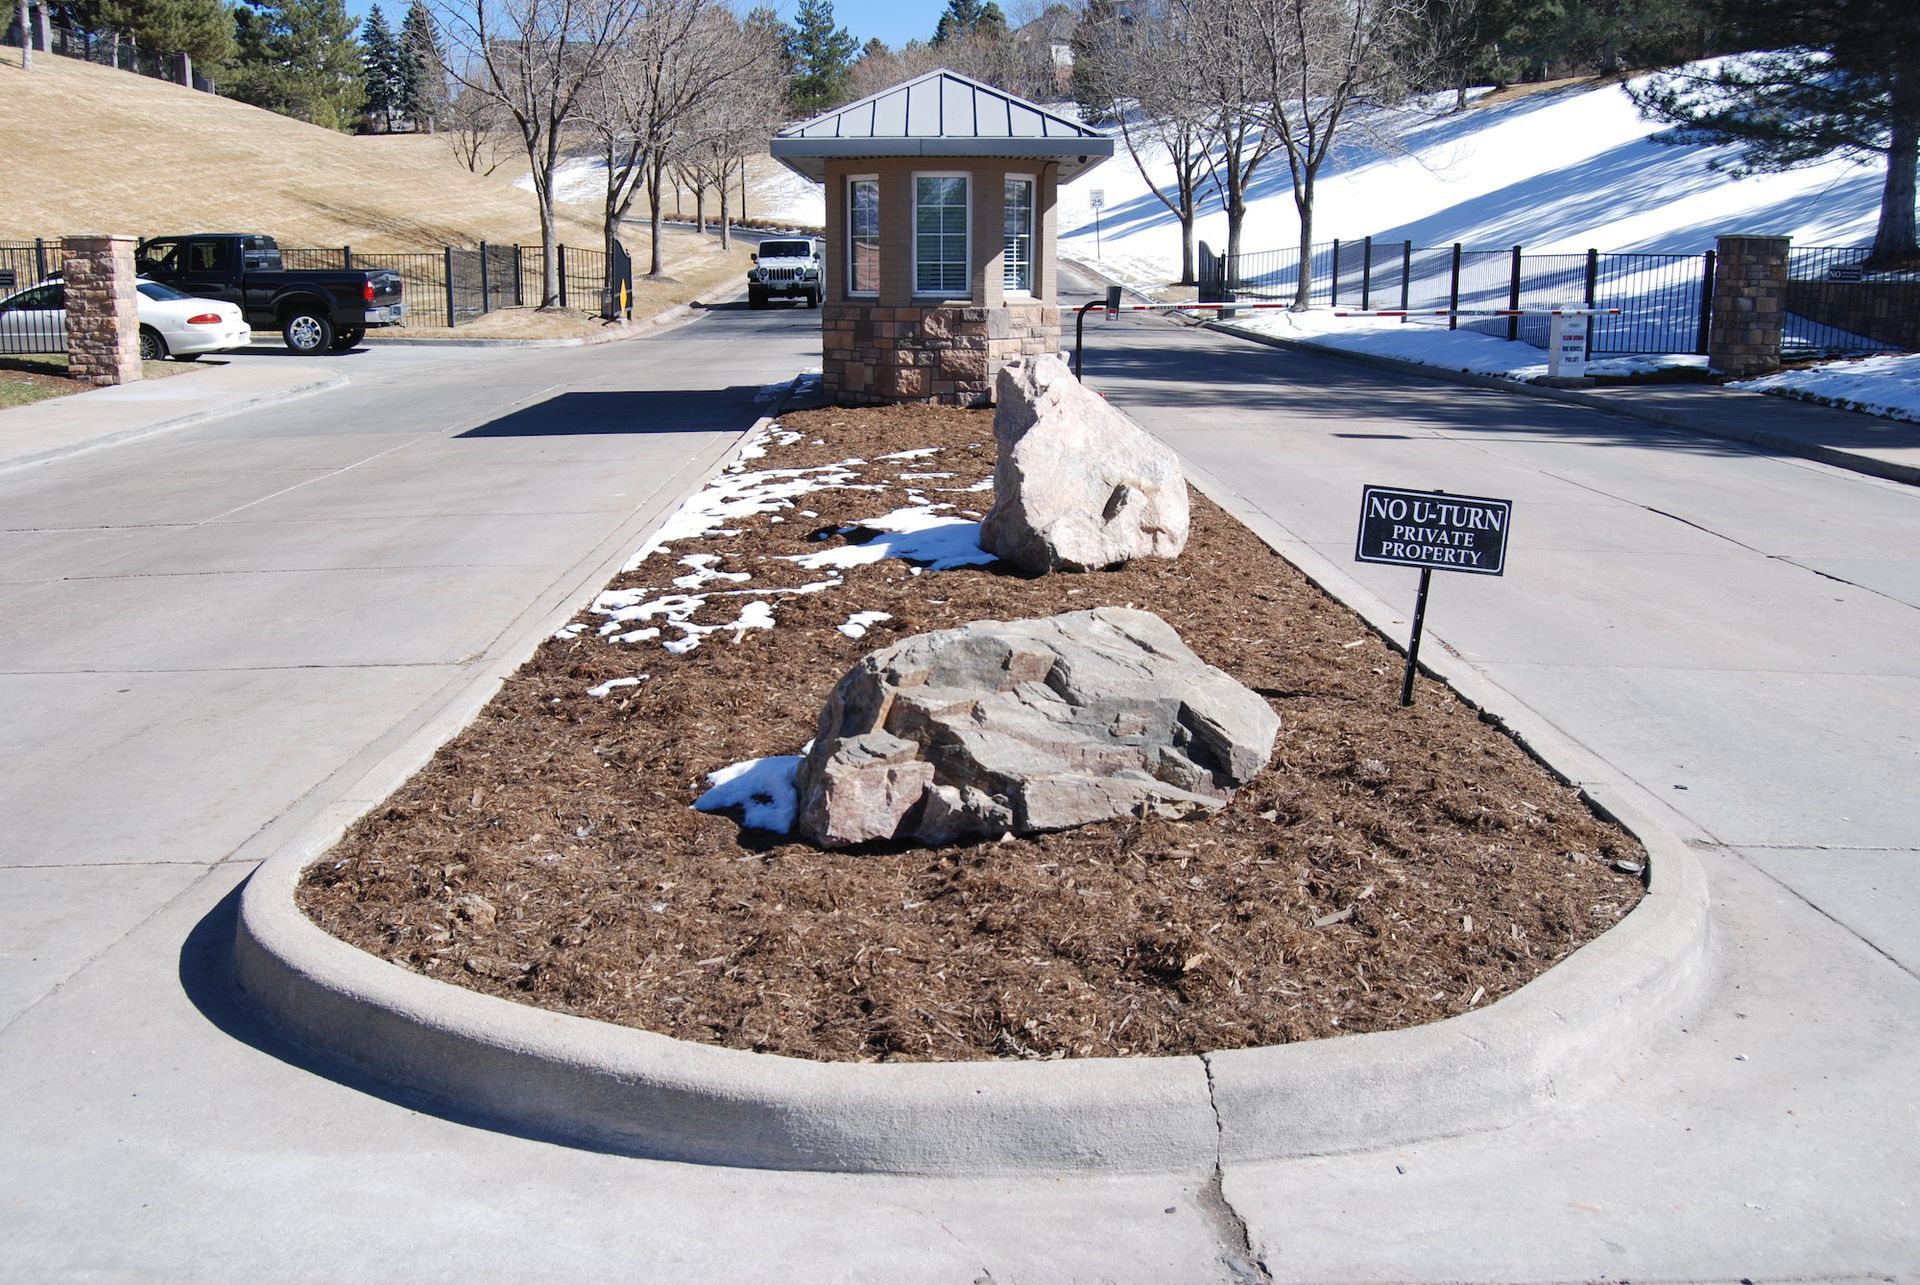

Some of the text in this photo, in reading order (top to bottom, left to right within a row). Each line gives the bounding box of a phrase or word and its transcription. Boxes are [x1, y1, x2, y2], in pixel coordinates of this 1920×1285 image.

[1830, 270, 1841, 279] NO
[1369, 496, 1504, 532] NO U-TURN
[1392, 524, 1475, 547] PRIVATE
[1381, 541, 1482, 565] PROPERTY
